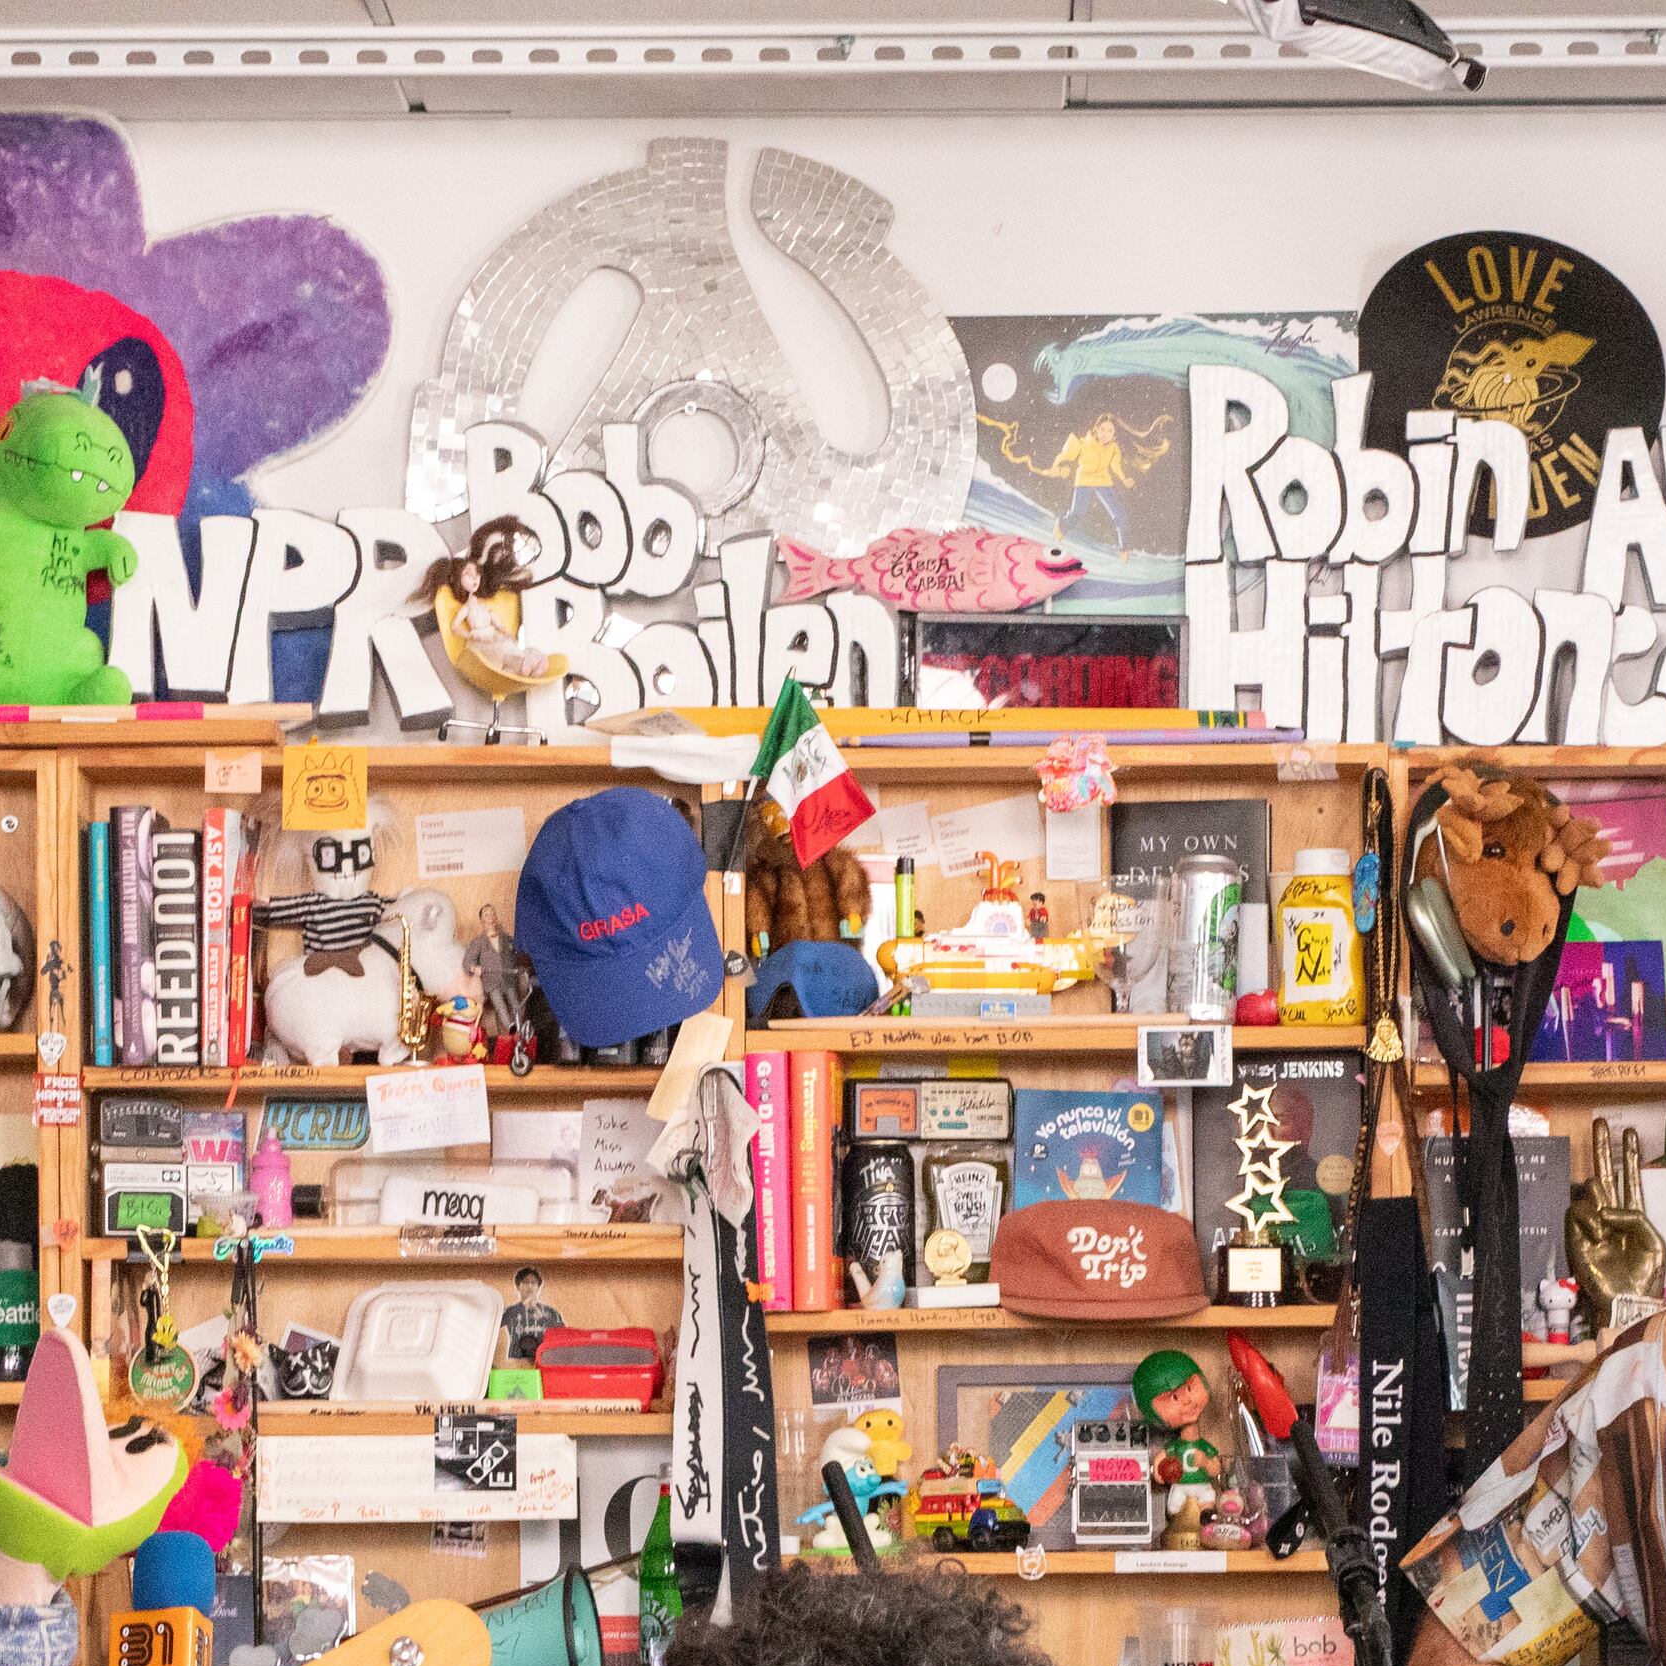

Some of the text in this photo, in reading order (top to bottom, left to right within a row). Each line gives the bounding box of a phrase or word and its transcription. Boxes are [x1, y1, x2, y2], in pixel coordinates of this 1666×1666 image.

[1425, 244, 1575, 314] LOVE
[1454, 305, 1558, 336] LAWRENCE
[1186, 364, 1533, 563] Robin
[465, 421, 704, 597] Bob
[110, 510, 454, 732] NPR
[523, 530, 900, 737] Boilen
[1186, 558, 1614, 748] Hilton
[1139, 834, 1239, 853] MY OWN
[204, 825, 223, 929] ASK BOB
[578, 900, 651, 943] GRASA
[1279, 1060, 1345, 1080] JENKINS
[1035, 1121, 1057, 1140] Yo
[1055, 1105, 1104, 1128] nunca
[1059, 1118, 1136, 1152] televisión
[948, 1170, 987, 1186] HEINZ
[421, 1188, 485, 1224] moog
[1068, 1225, 1147, 1261] Don't
[1082, 1253, 1148, 1288] Trip
[1371, 1357, 1405, 1447] Nile
[1292, 1634, 1337, 1657] bob
